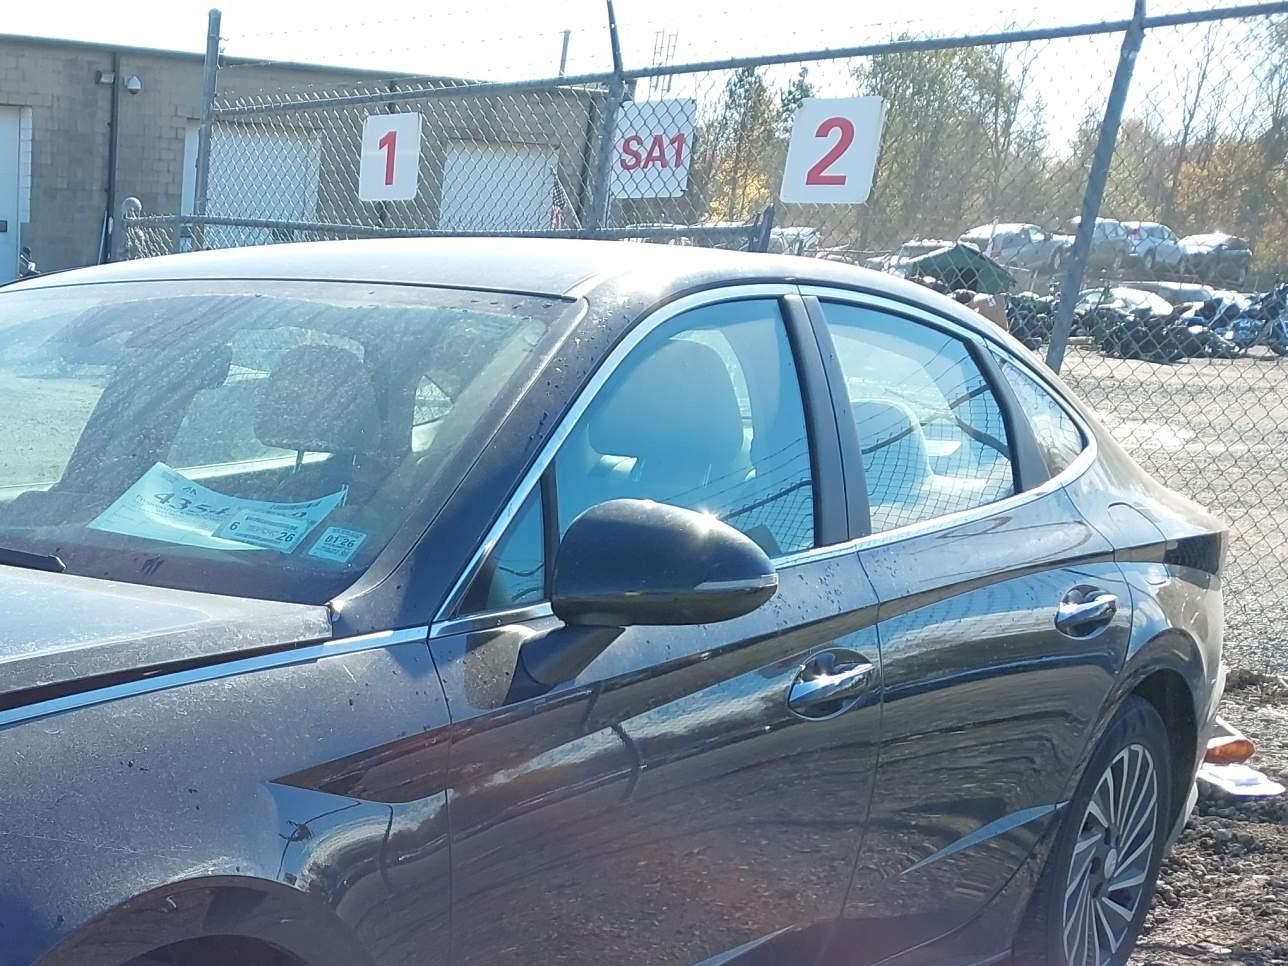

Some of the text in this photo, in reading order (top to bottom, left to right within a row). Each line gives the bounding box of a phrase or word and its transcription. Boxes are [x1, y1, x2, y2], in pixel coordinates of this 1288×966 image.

[379, 131, 397, 185] 1
[620, 133, 686, 169] SA1
[806, 117, 854, 185] 2
[276, 532, 296, 543] 26
